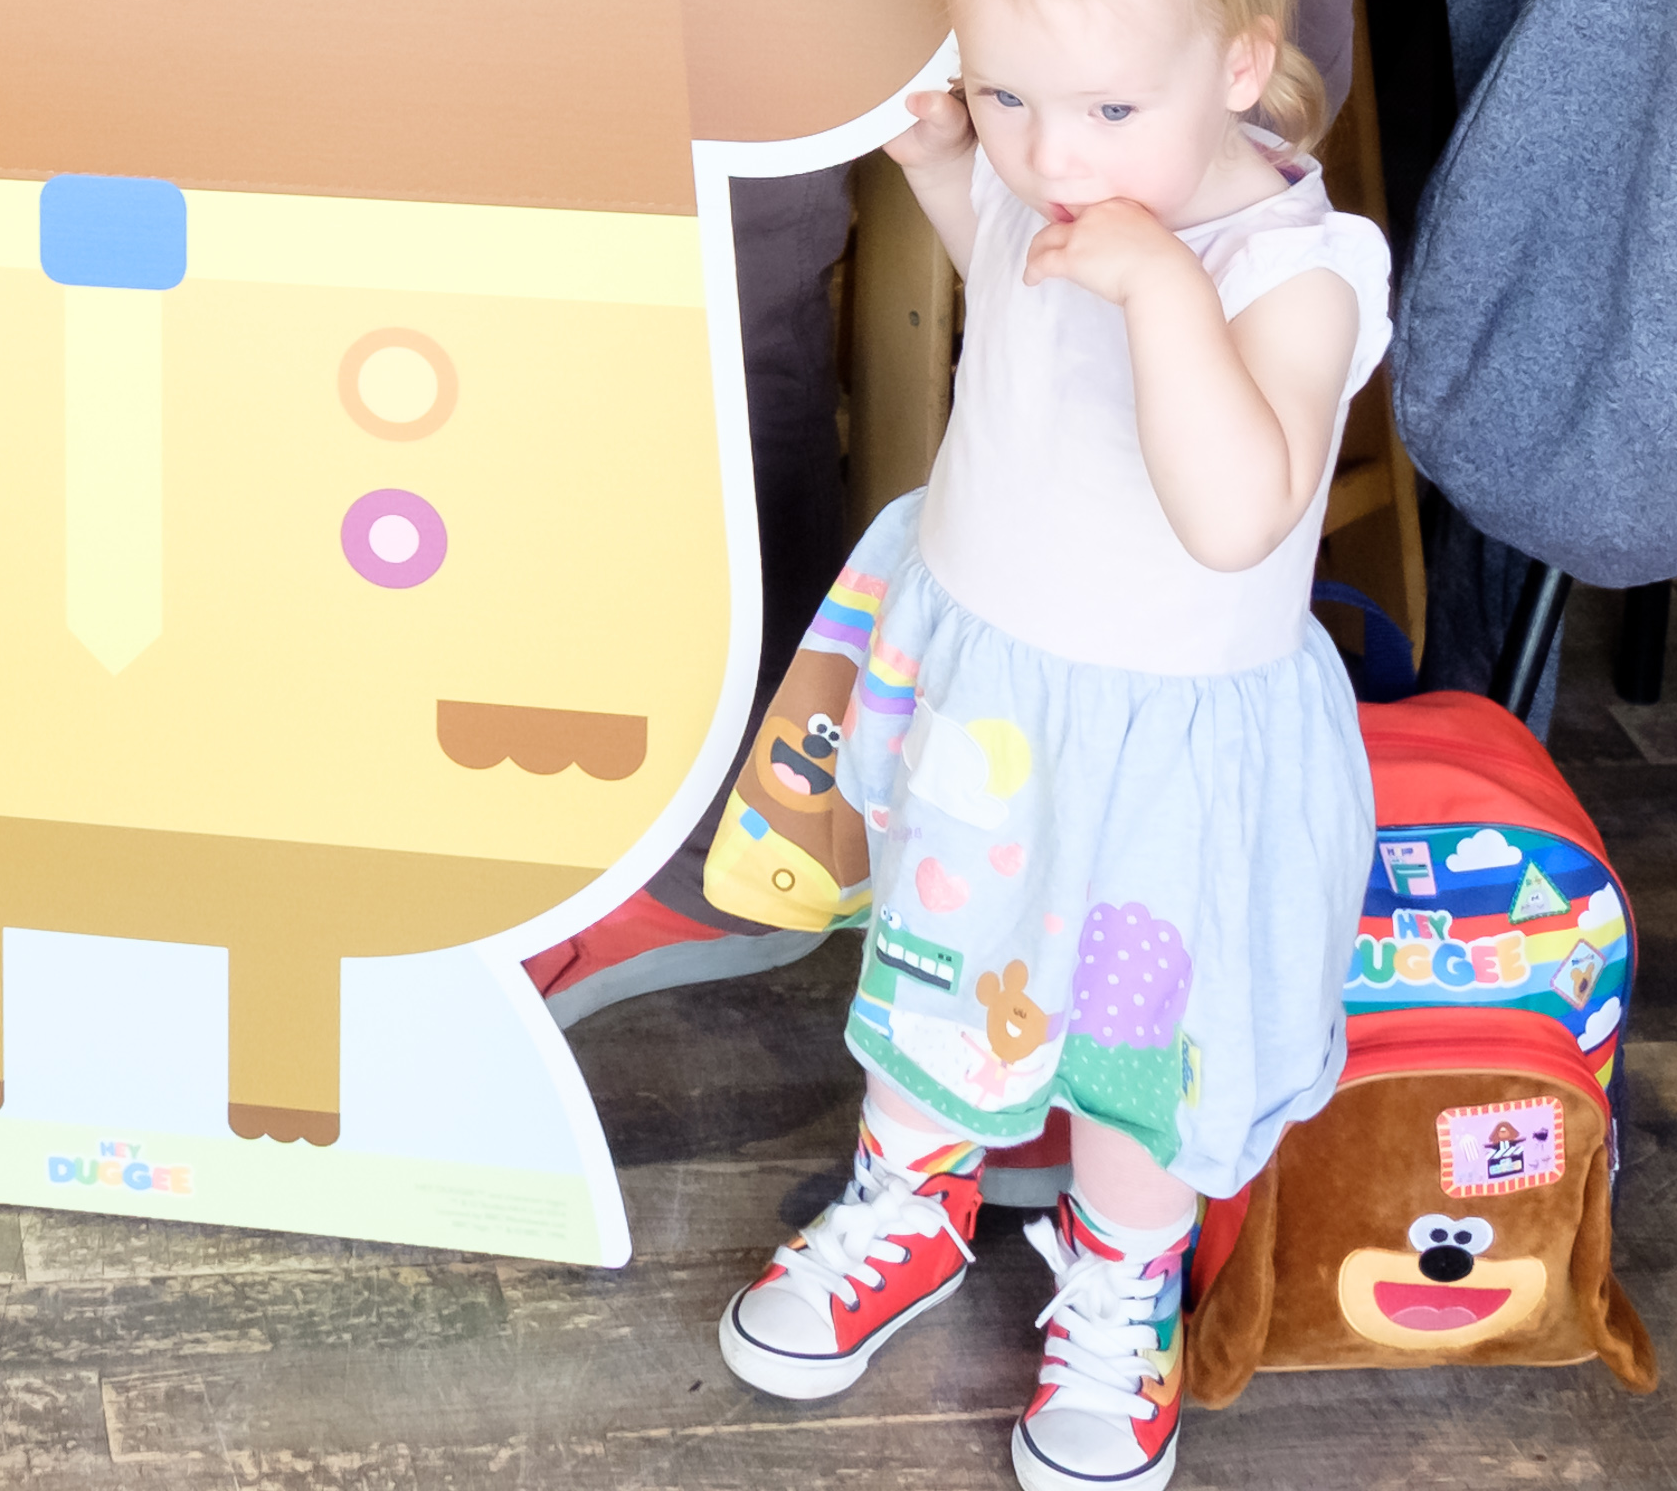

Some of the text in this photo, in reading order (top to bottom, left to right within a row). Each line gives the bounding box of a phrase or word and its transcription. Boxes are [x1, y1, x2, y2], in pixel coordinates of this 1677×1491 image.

[1397, 913, 1448, 940] HEY
[100, 1140, 142, 1159] HEY
[48, 1156, 194, 1195] DUGGEE
